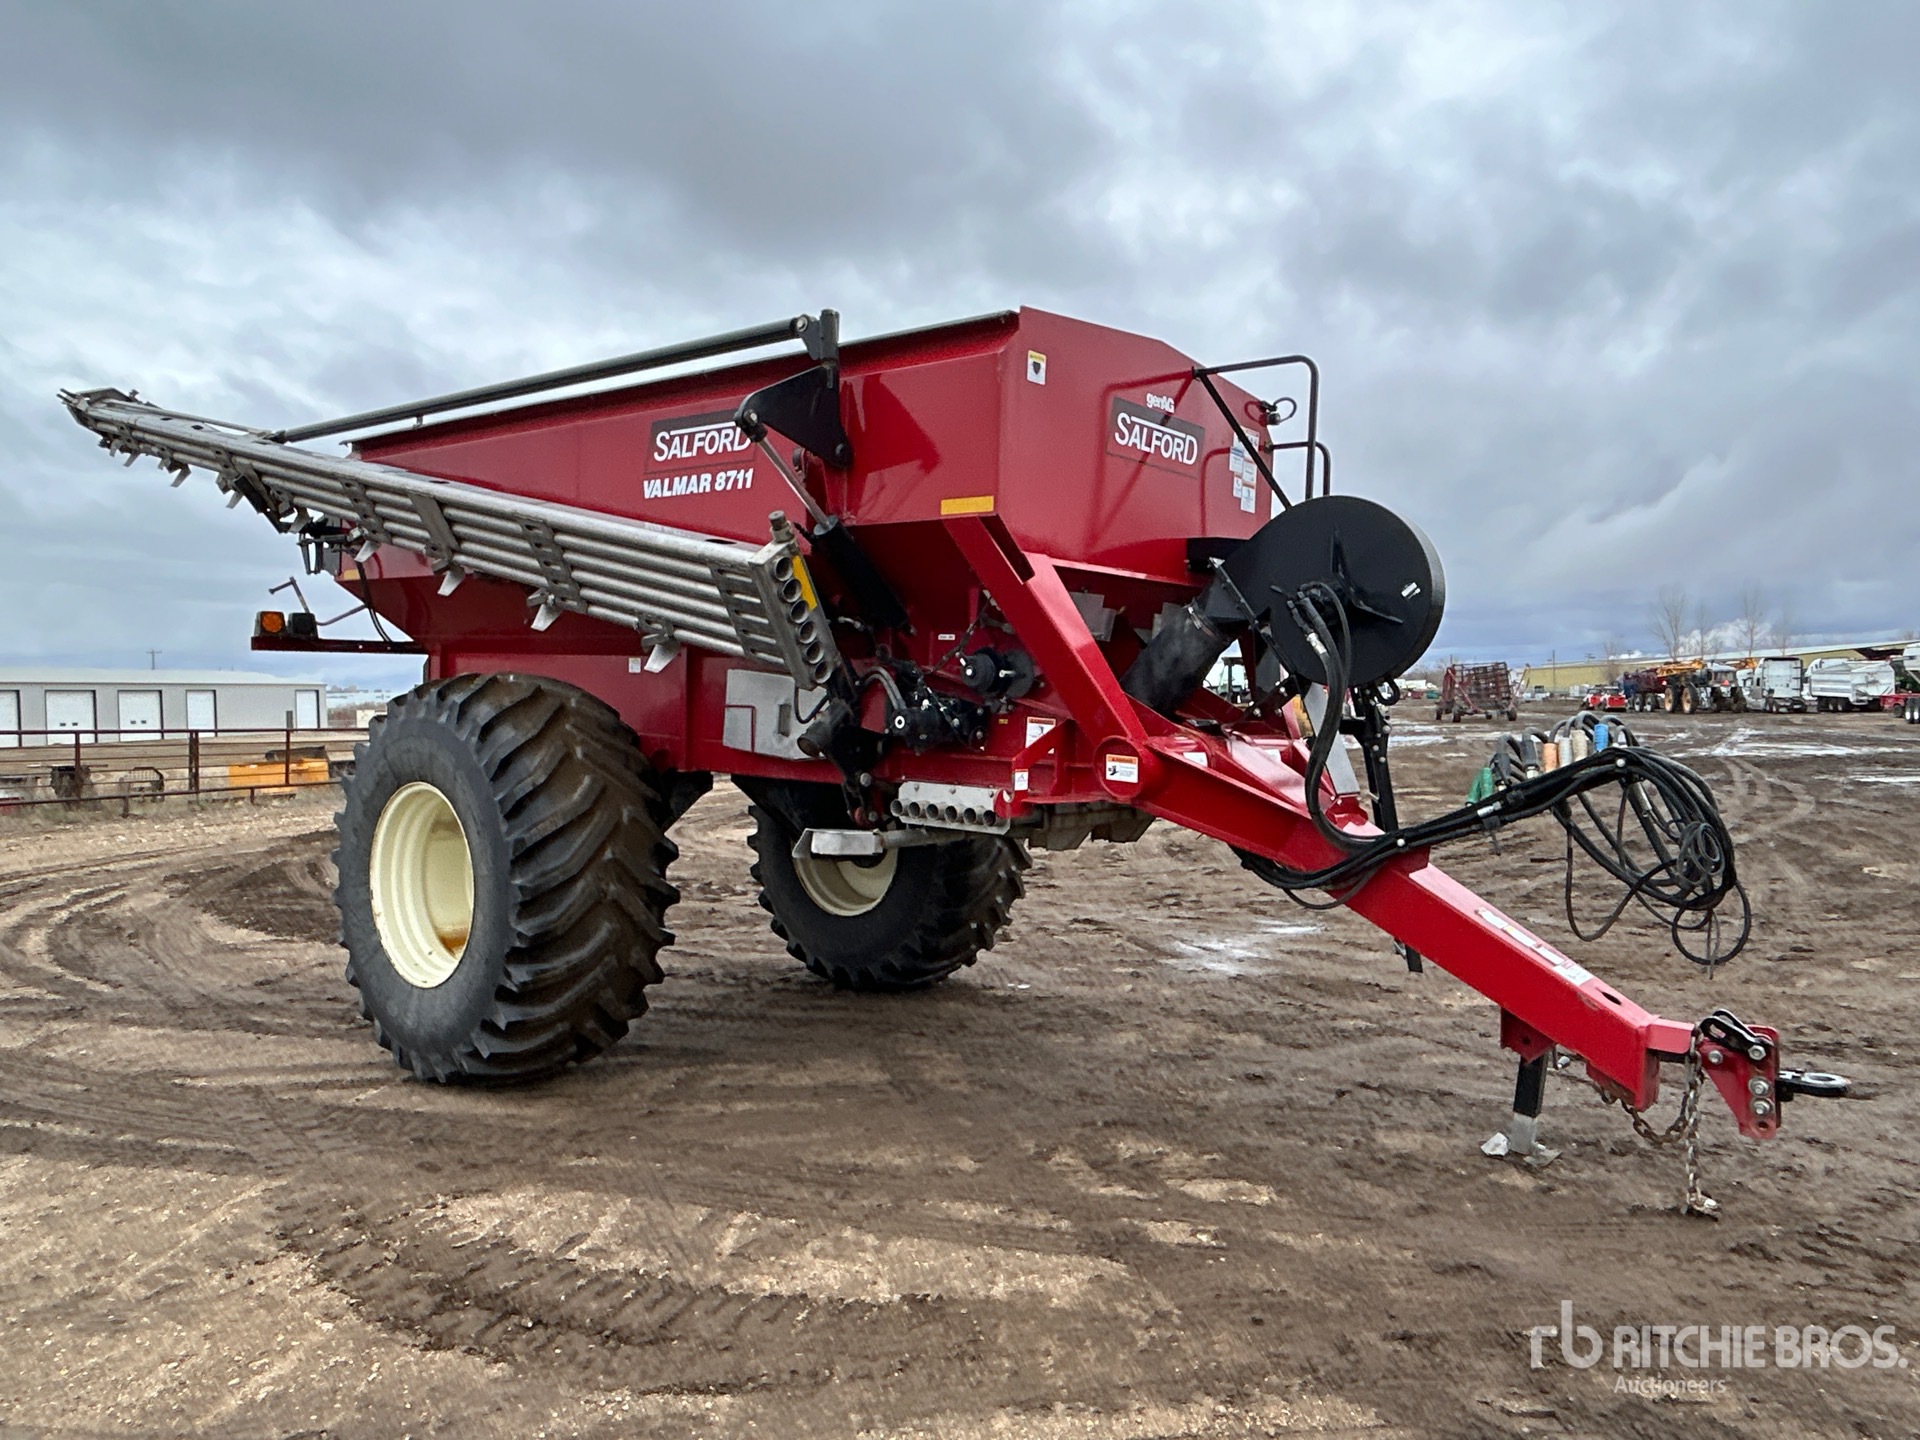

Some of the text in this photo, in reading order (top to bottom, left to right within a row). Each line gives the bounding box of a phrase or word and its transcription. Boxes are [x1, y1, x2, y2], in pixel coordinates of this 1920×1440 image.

[1114, 412, 1198, 465] SALFORD
[643, 468, 754, 499] VALMAR 8711
